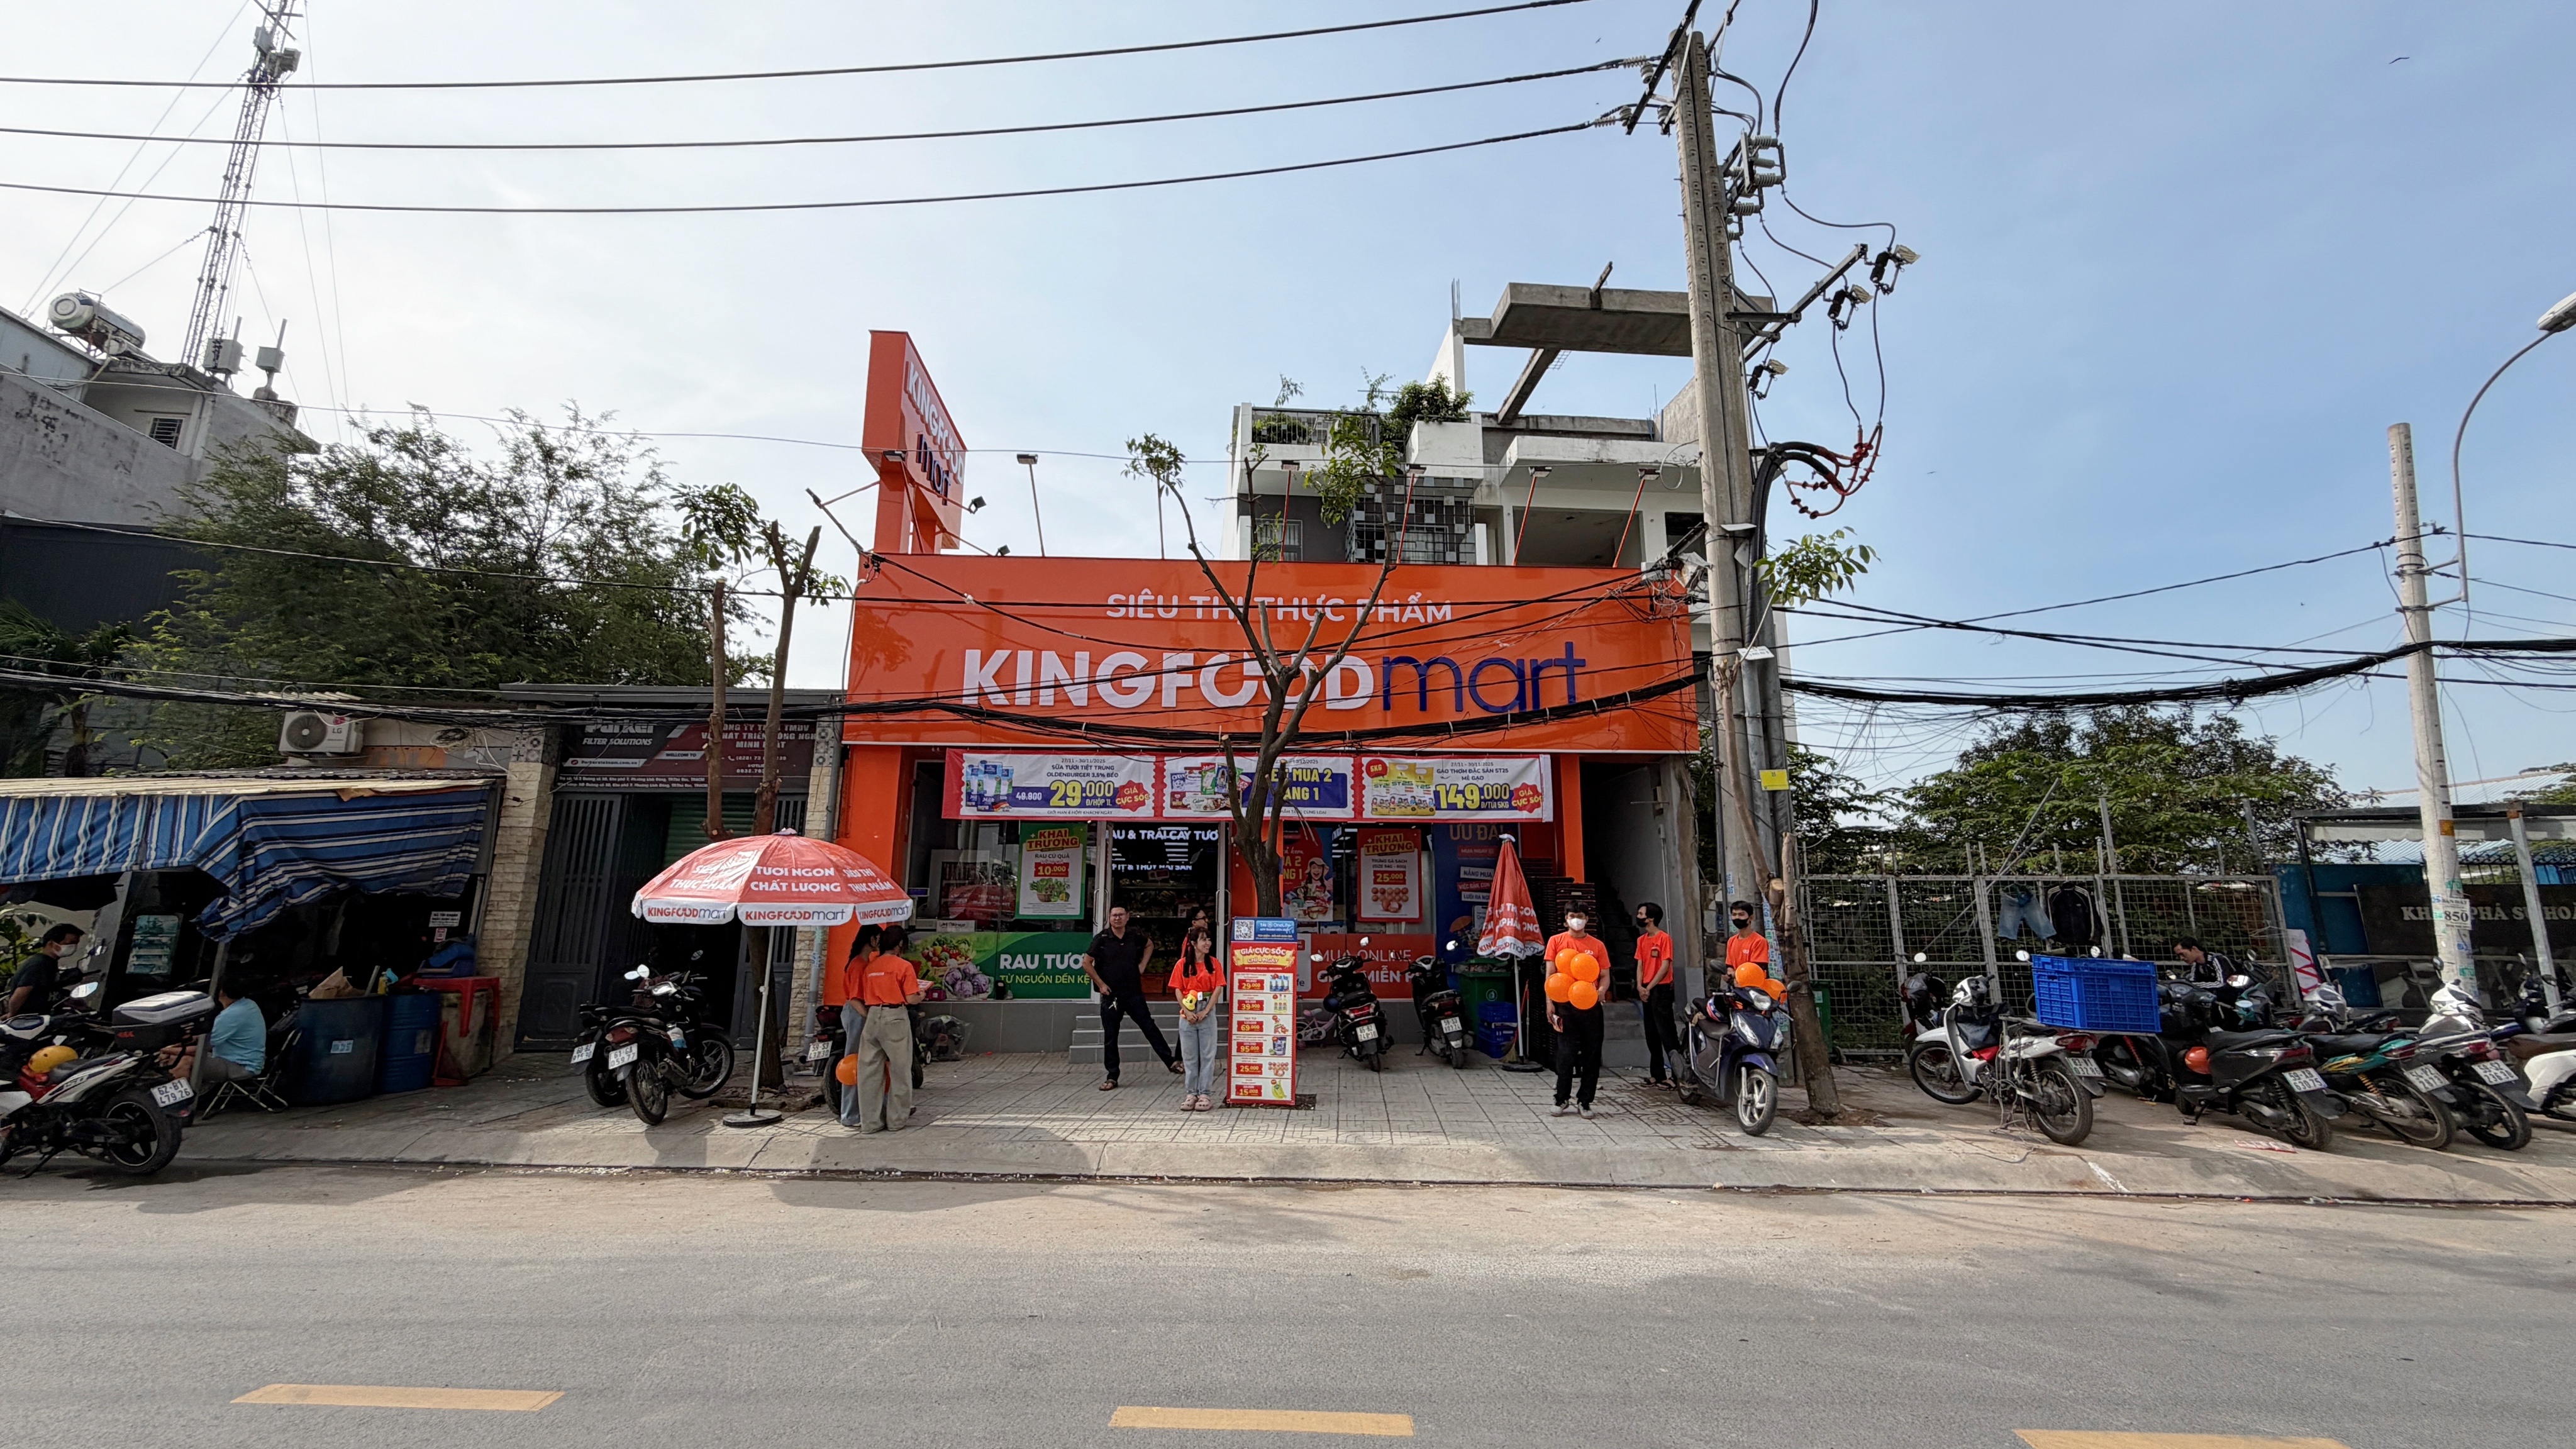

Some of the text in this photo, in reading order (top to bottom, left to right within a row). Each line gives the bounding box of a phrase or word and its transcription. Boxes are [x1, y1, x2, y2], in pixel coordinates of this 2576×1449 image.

[907, 361, 964, 484] KINGFOOD
[1106, 588, 1179, 619] SIÊU
[1357, 592, 1452, 625] PHẨM
[609, 738, 653, 746] SOLUTIONS
[1370, 764, 1382, 772] 5KG
[1292, 768, 1320, 782] MUA
[1323, 769, 1333, 782] 2
[1050, 779, 1115, 808] 29.000
[1124, 785, 1138, 795] GIÁ
[1313, 787, 1319, 801] 1
[1519, 787, 1533, 797] GIÁ
[1115, 790, 1151, 806] CỰC SỐC
[1435, 783, 1510, 809] 149.000
[1511, 797, 1528, 808] CỰC
[1039, 830, 1067, 840] KHAI
[1128, 830, 1136, 840] &
[1376, 835, 1403, 843] KHAI
[1028, 838, 1078, 849] TRƯƠNG
[1365, 842, 1413, 853] TRƯƠNG
[1295, 856, 1301, 867] 2
[791, 867, 835, 877] NGON
[1038, 866, 1066, 875] 10.000
[1299, 869, 1302, 880] 1
[1376, 873, 1404, 882] 25.000
[750, 879, 841, 894] CHẤT LƯỢNG
[2445, 911, 2469, 922] 850
[1241, 947, 1286, 956] GIÁ CỰC SỐC
[999, 952, 1085, 969] RAU TƯƠ
[1055, 973, 1075, 984] ĐẾN
